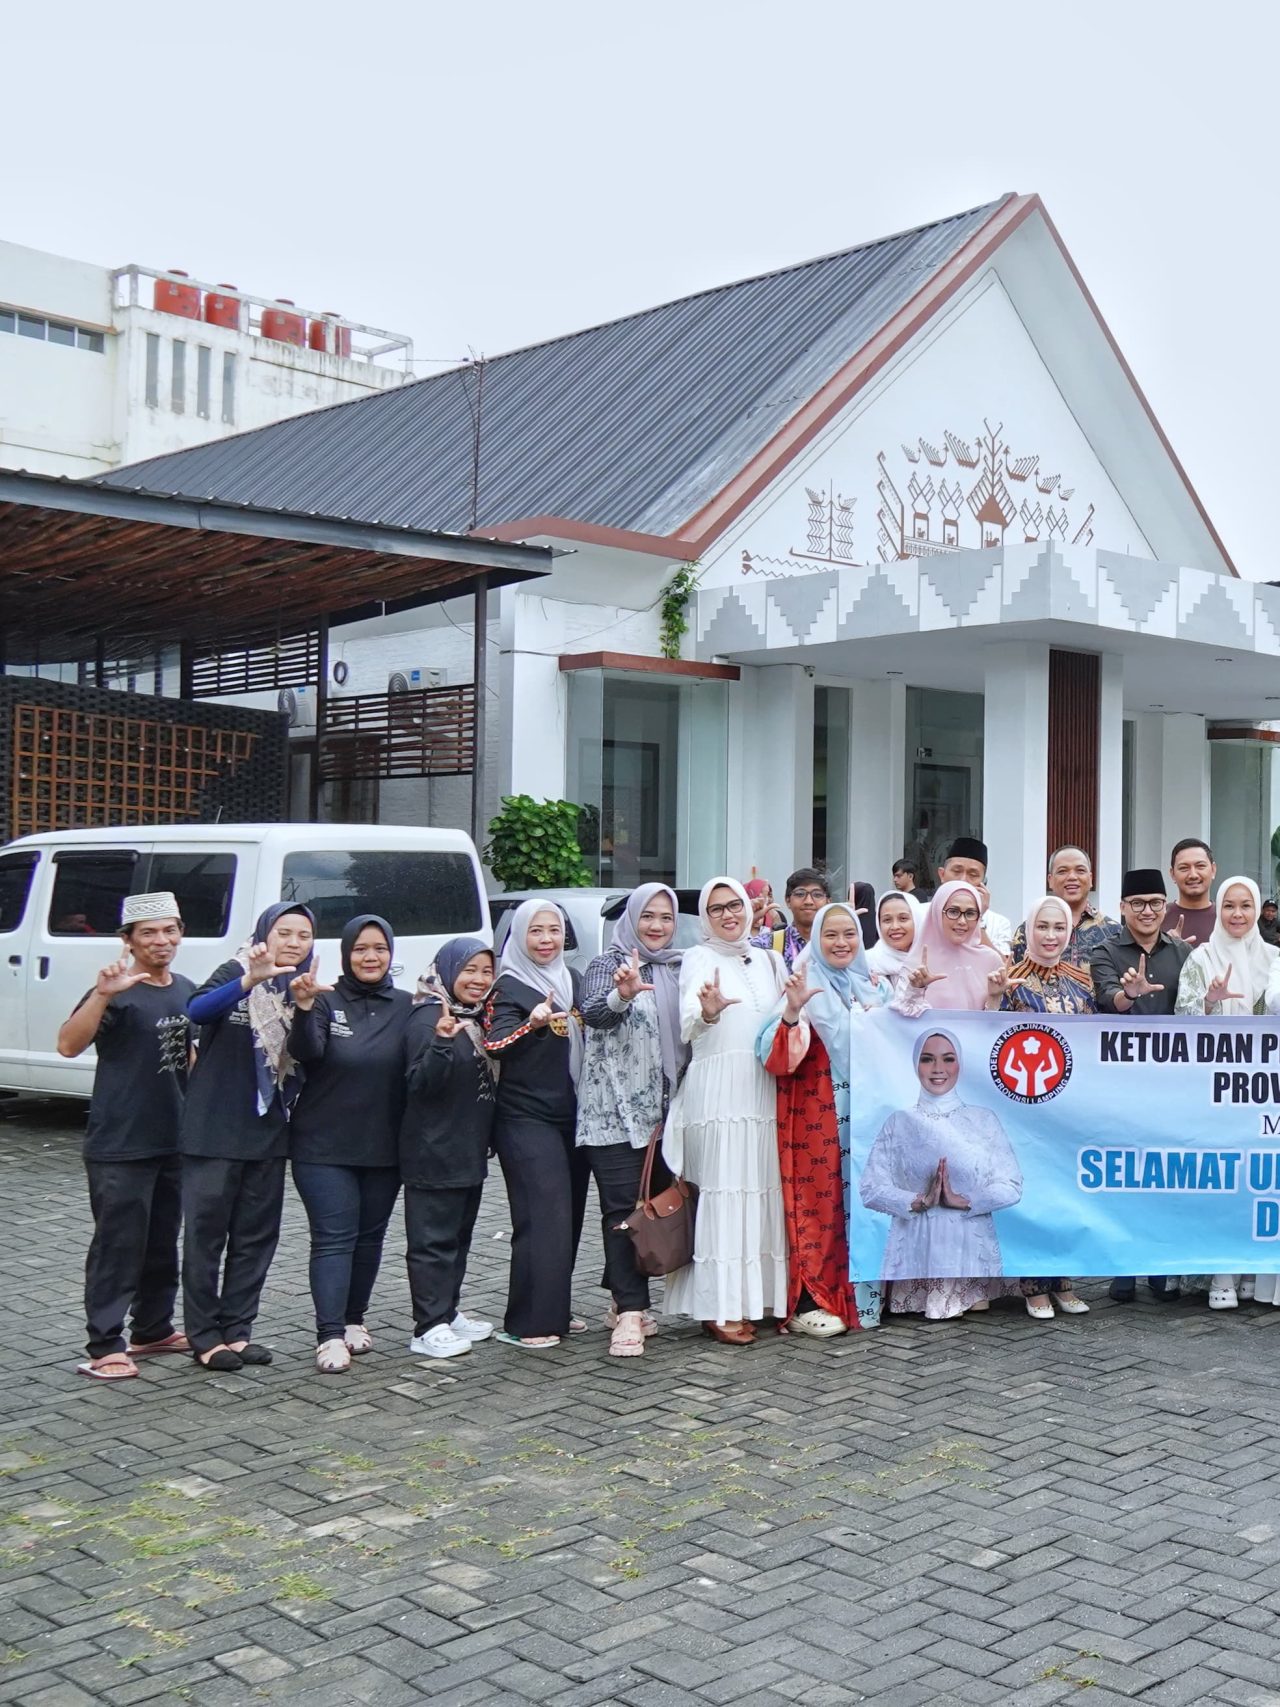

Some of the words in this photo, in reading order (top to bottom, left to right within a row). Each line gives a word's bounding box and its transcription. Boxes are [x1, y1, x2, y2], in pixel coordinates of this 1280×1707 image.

[990, 1039, 1004, 1070] DEWAN
[1003, 1024, 1050, 1039] KERAJINAN
[1051, 1029, 1072, 1071] NASIONAL
[1100, 1031, 1189, 1062] KETUA
[1197, 1032, 1253, 1063] DAN
[832, 1081, 850, 1091] BNB
[994, 1078, 1029, 1104] PROVINSI
[1031, 1079, 1068, 1104] LAMPUNG
[819, 1103, 836, 1112] BNB
[806, 1122, 822, 1131] BNB
[823, 1137, 839, 1147] BNB
[811, 1157, 827, 1166] BNB
[1080, 1149, 1241, 1189] SELAMAT
[798, 1176, 815, 1184] BNB
[816, 1190, 832, 1199] BNB
[805, 1241, 821, 1249] BNB
[857, 1308, 875, 1317] BNB
